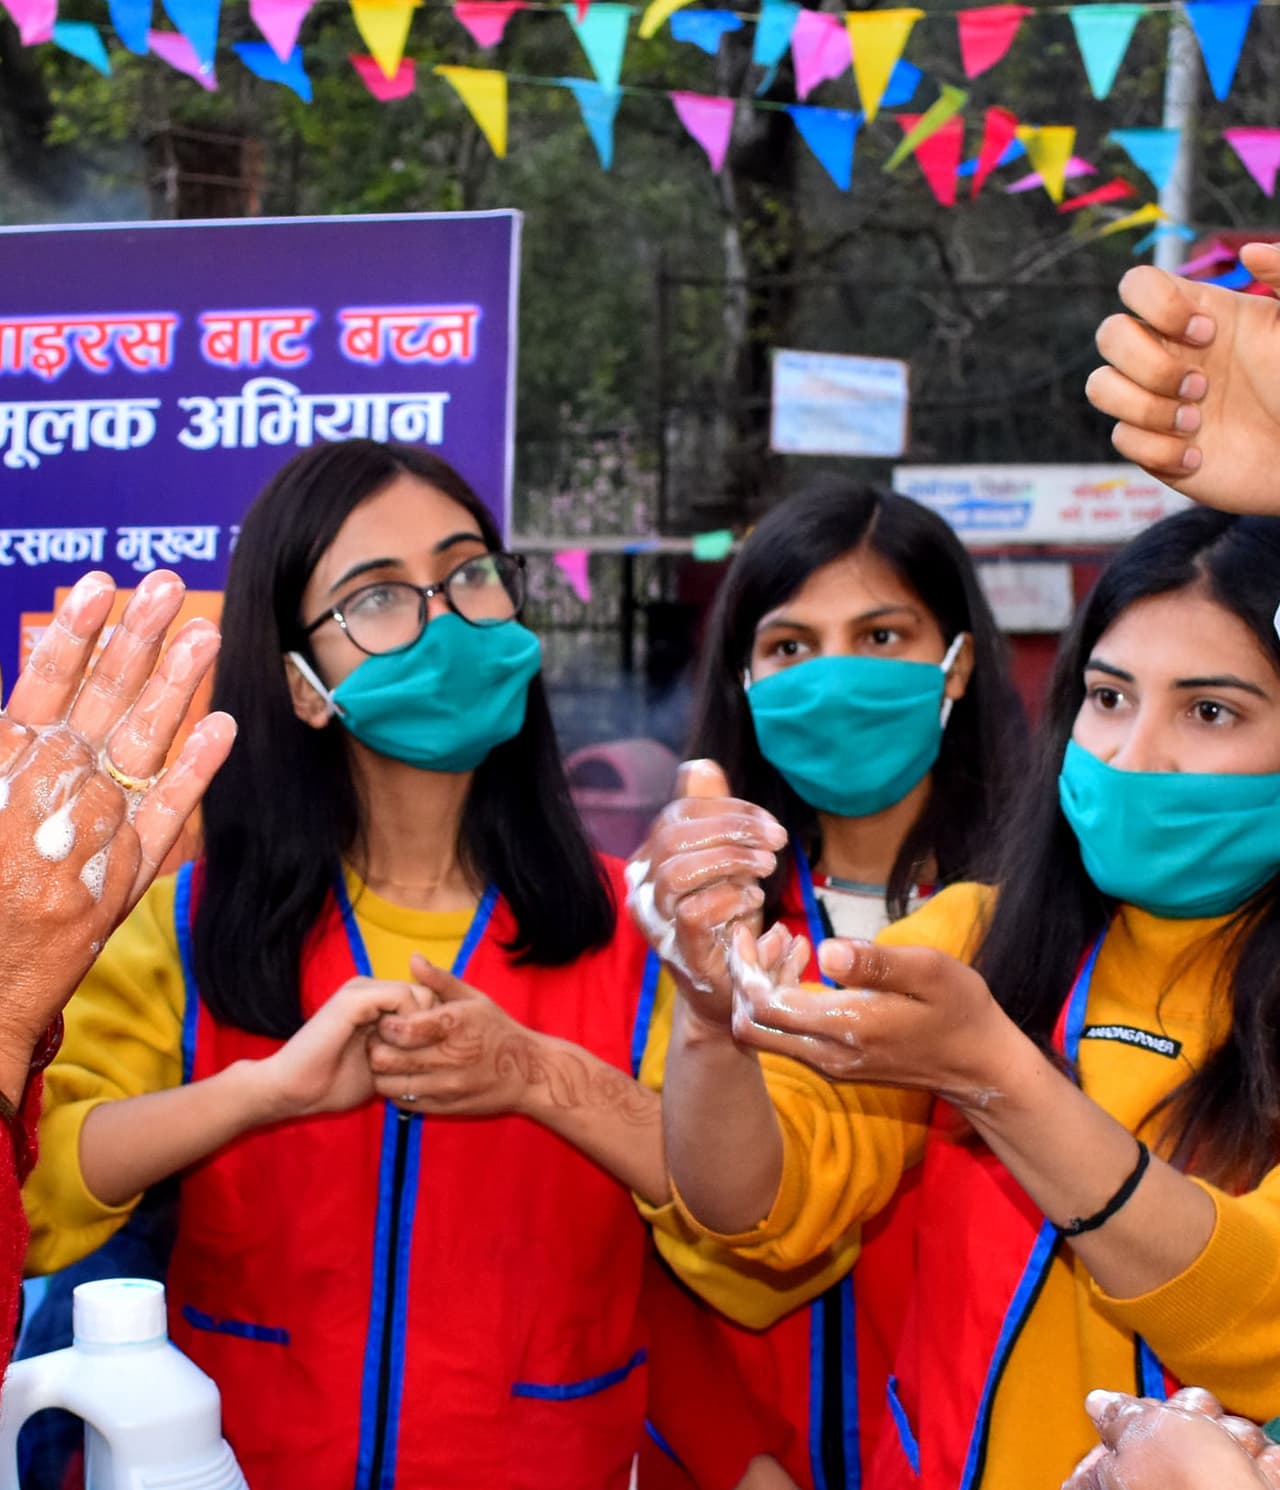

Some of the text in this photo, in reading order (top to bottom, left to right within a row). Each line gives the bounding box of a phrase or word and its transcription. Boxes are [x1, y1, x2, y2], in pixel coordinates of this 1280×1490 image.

[199, 309, 317, 365] बाट
[337, 304, 480, 362] बच्न
[178, 377, 450, 449] अभियान
[116, 526, 220, 571] मुख्य
